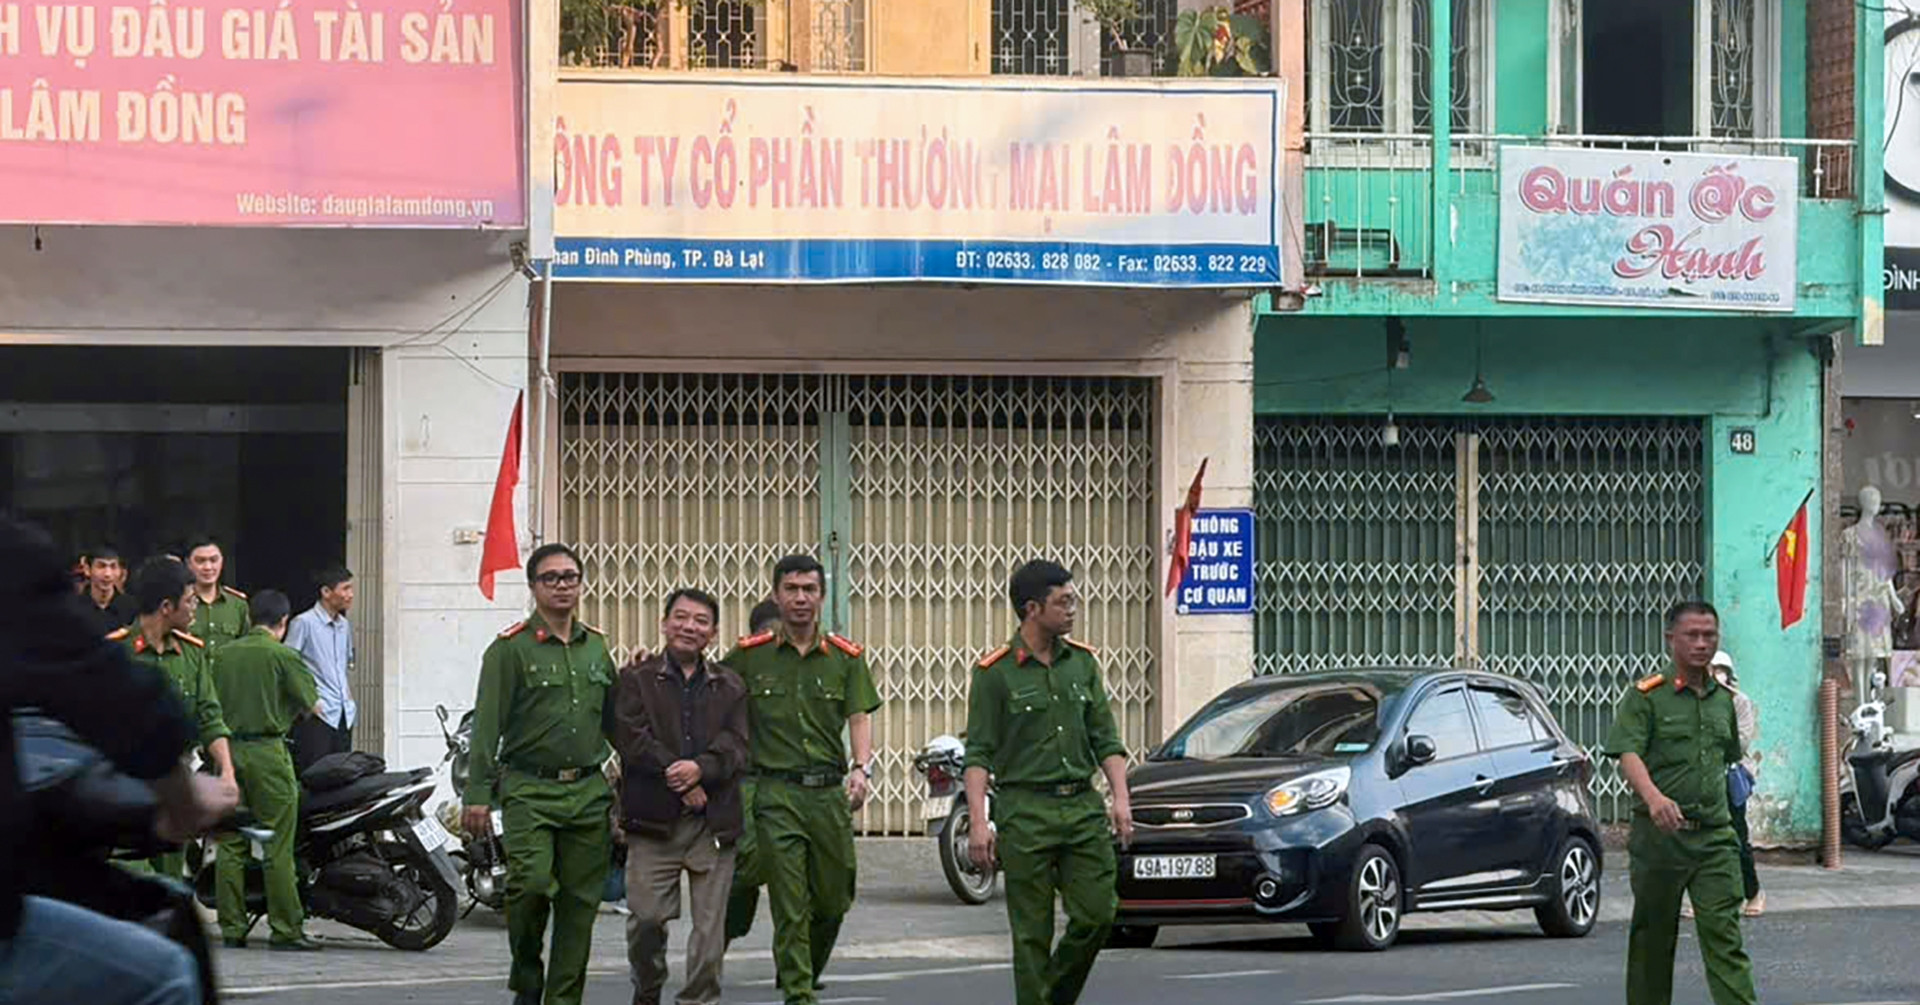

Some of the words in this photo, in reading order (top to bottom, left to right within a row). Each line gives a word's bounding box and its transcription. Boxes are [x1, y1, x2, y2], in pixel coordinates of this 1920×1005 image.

[34, 5, 96, 68] VỤ
[221, 3, 300, 61] GIÁ
[313, 3, 385, 62] TÀI
[400, 0, 495, 64] SẢN
[1, 78, 100, 141] LÂM
[116, 74, 246, 144] ĐỒNG
[553, 115, 623, 207] ÔNG
[634, 136, 680, 207] TY
[689, 98, 738, 209] CỔ
[749, 105, 844, 209] PHẦN
[1008, 142, 1071, 233] MẠI
[1082, 126, 1152, 214] LÂM
[1166, 112, 1258, 215] ĐỒNG
[1519, 165, 1675, 218] Quán
[236, 193, 317, 214] Website:
[552, 249, 578, 266] han
[585, 247, 619, 266] Đình
[625, 248, 676, 270] Phùng,
[683, 250, 707, 268] TP.
[714, 250, 734, 268] Đà
[740, 250, 764, 271] Lạt
[956, 250, 981, 268] ĐT:
[986, 251, 1036, 270] 02633.
[1042, 252, 1069, 269] 828
[1075, 253, 1101, 271] 082
[1118, 255, 1148, 272] Fax:
[1154, 255, 1202, 272] 02633.
[1208, 254, 1235, 271] 822
[1240, 256, 1267, 273] 229
[1611, 224, 1768, 284] Hạnh
[1731, 433, 1753, 451] 48
[1190, 514, 1239, 534] KHÔNG
[1223, 541, 1243, 557] XE
[1191, 561, 1239, 580] TRƯỚC
[1184, 585, 1203, 604] CƠ
[1207, 586, 1246, 606] QUAN
